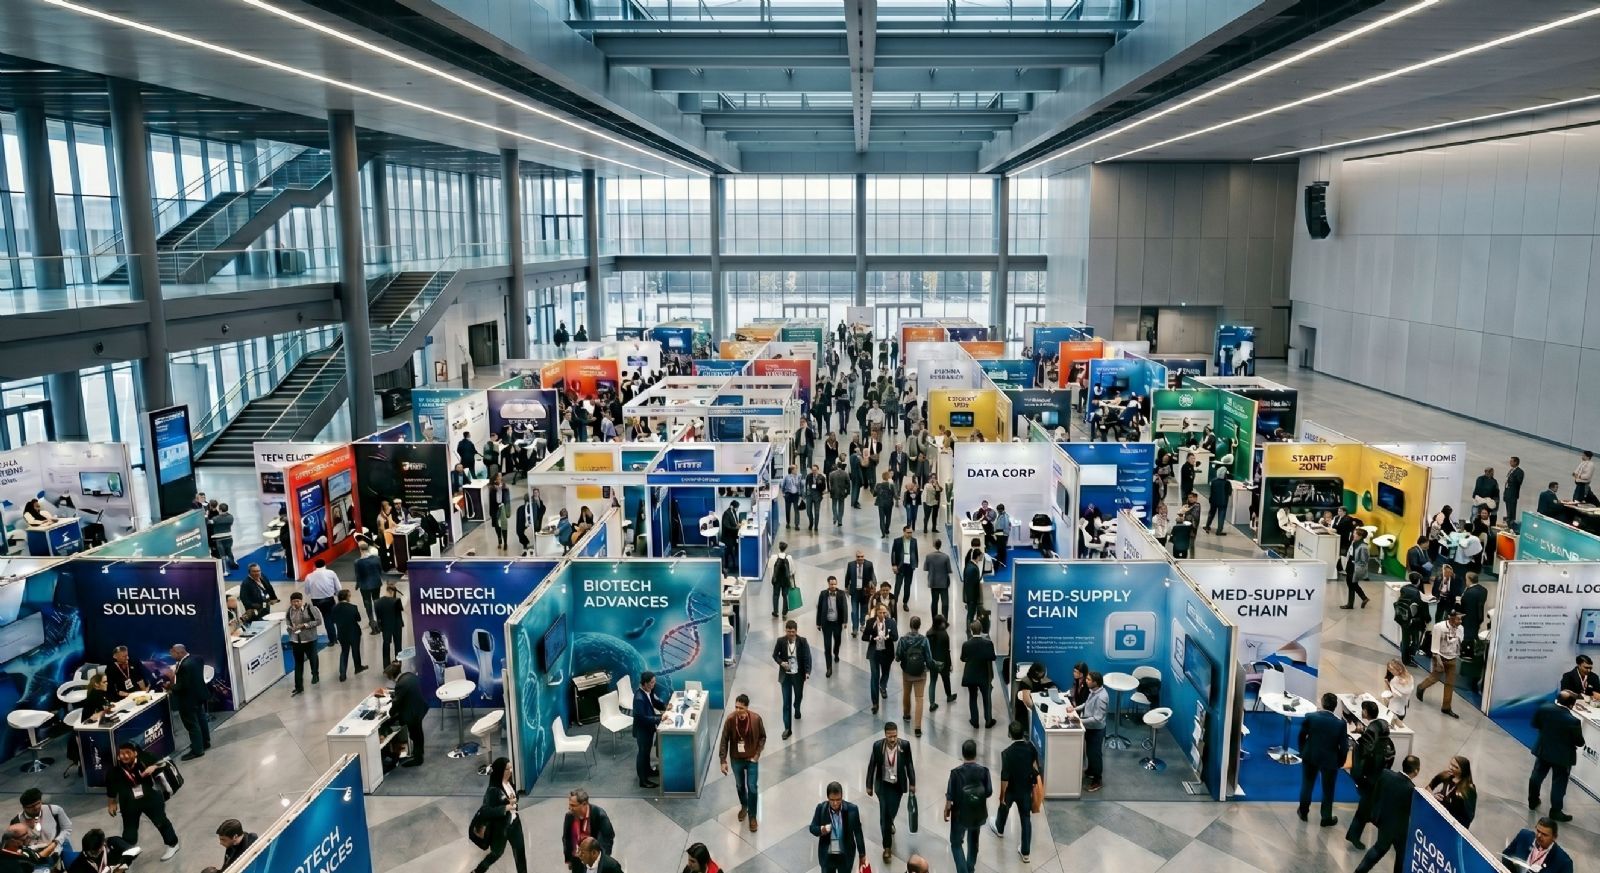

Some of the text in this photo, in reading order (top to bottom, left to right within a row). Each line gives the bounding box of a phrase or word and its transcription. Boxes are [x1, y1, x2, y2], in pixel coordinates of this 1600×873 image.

[1291, 454, 1334, 463] STARTUP
[967, 468, 1036, 478] DATA CORP
[1298, 462, 1327, 471] ZONE
[583, 579, 652, 593] BIOTECH
[1521, 583, 1574, 594] GLOBAL
[116, 587, 180, 600] HEALTH
[419, 587, 496, 600] MEDTECH
[1027, 589, 1132, 603] MED-SUPPLY
[1211, 588, 1316, 601] MED-SUPPLY
[583, 595, 669, 609] ADVANCES
[103, 602, 197, 616] SOLUTIONS
[1026, 605, 1079, 619] CHAIN
[1236, 604, 1289, 618] CHAIN
